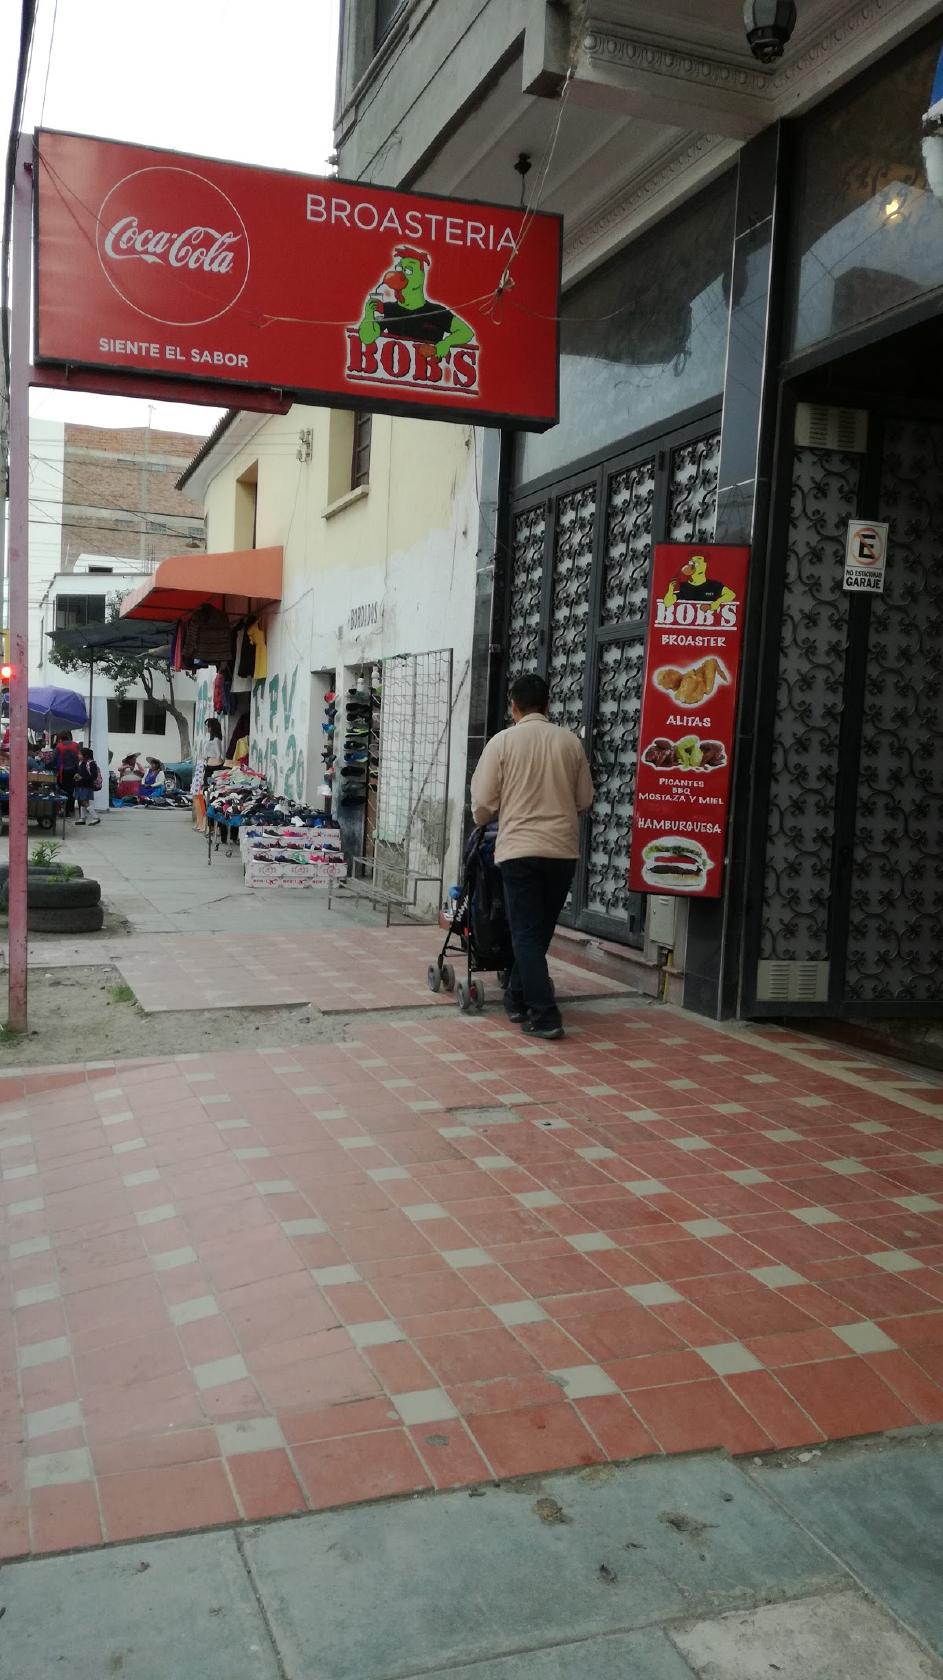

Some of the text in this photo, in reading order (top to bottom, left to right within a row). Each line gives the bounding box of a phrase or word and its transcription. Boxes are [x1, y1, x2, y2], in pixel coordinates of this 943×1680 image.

[306, 193, 519, 251] BROASTERIA
[99, 338, 249, 368] SIENTE EL SABOR
[346, 334, 477, 388] BOB'S
[845, 576, 881, 589] GARAJE
[655, 602, 737, 627] BOB'S
[661, 634, 727, 647] BROASTER
[666, 715, 711, 727] ALITAS
[659, 777, 705, 788] PICANTES
[672, 787, 691, 795] BBQ
[638, 792, 725, 805] MOSTAZA Y MIEL
[637, 817, 722, 834] HAMBURGUESA
